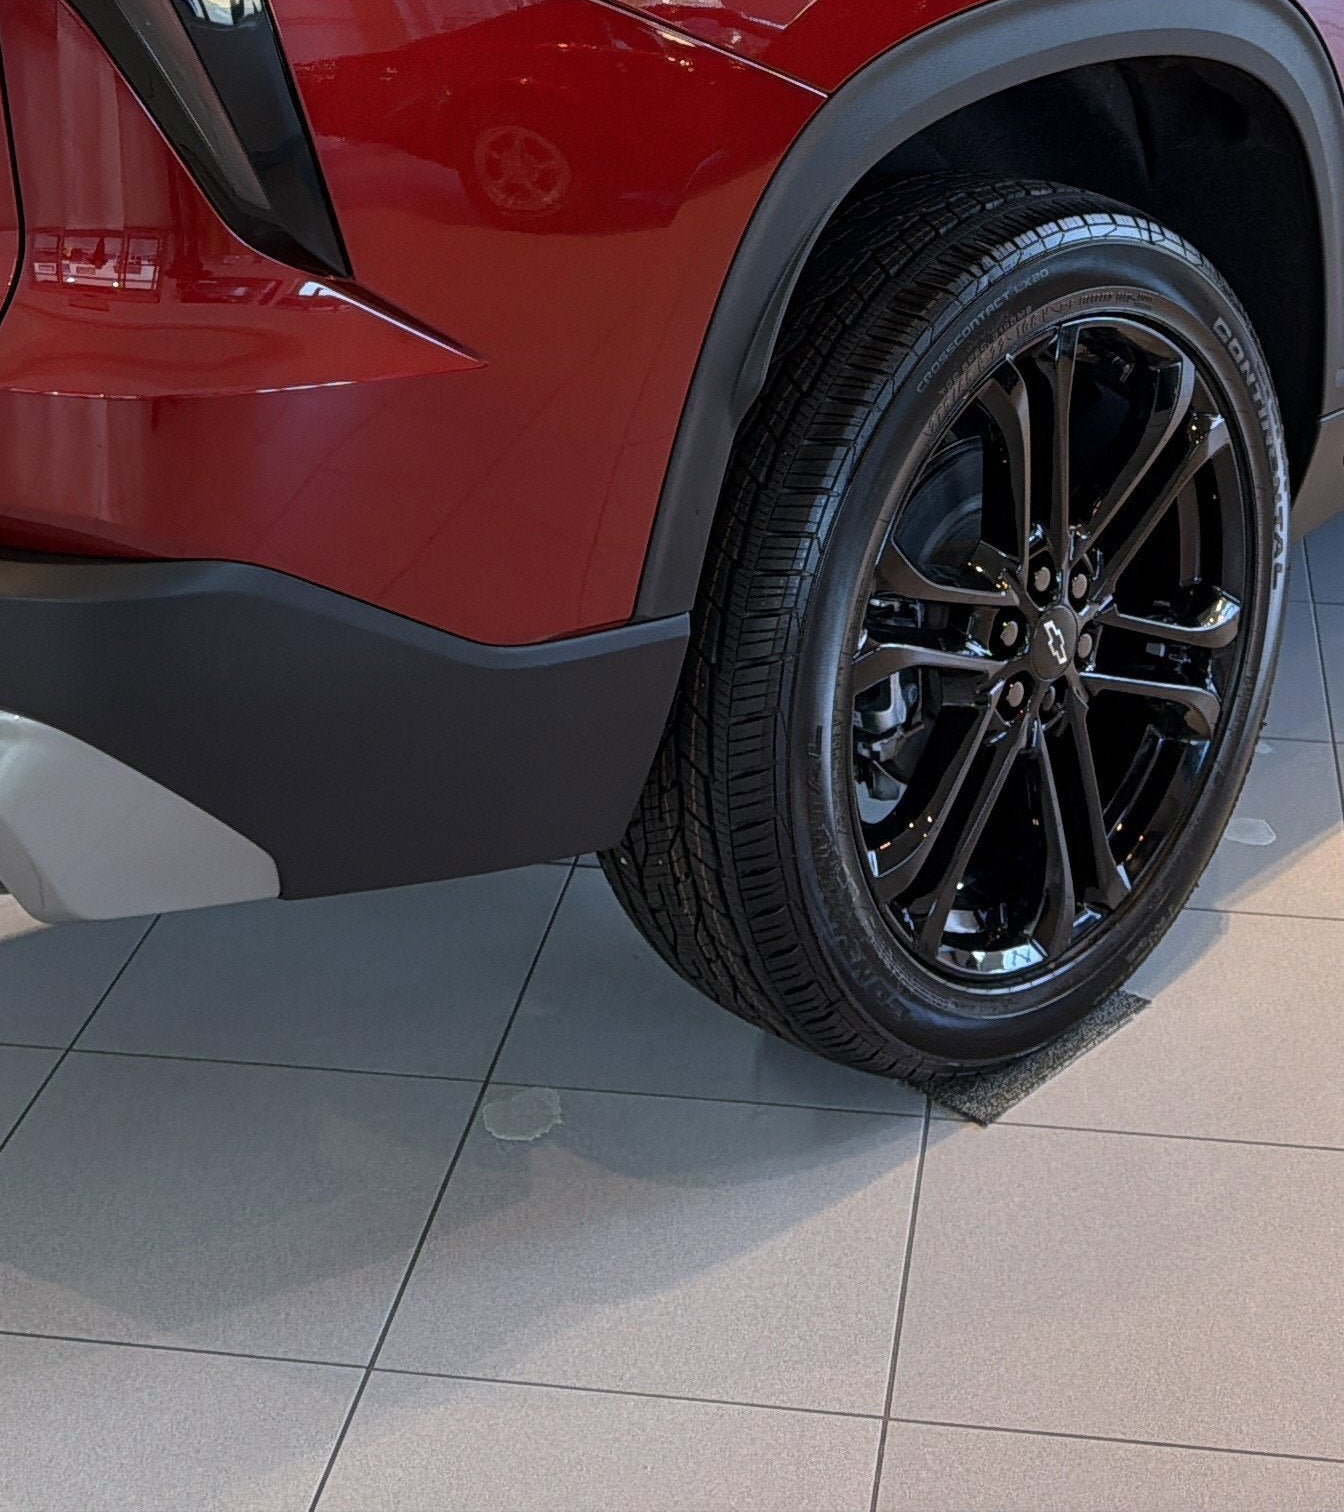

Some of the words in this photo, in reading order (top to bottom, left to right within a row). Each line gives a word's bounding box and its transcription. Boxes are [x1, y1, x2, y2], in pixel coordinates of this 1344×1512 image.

[915, 288, 1012, 394] CROSSCONTACT
[1013, 267, 1050, 295] LX20
[1212, 316, 1292, 592] CONTINENTAL
